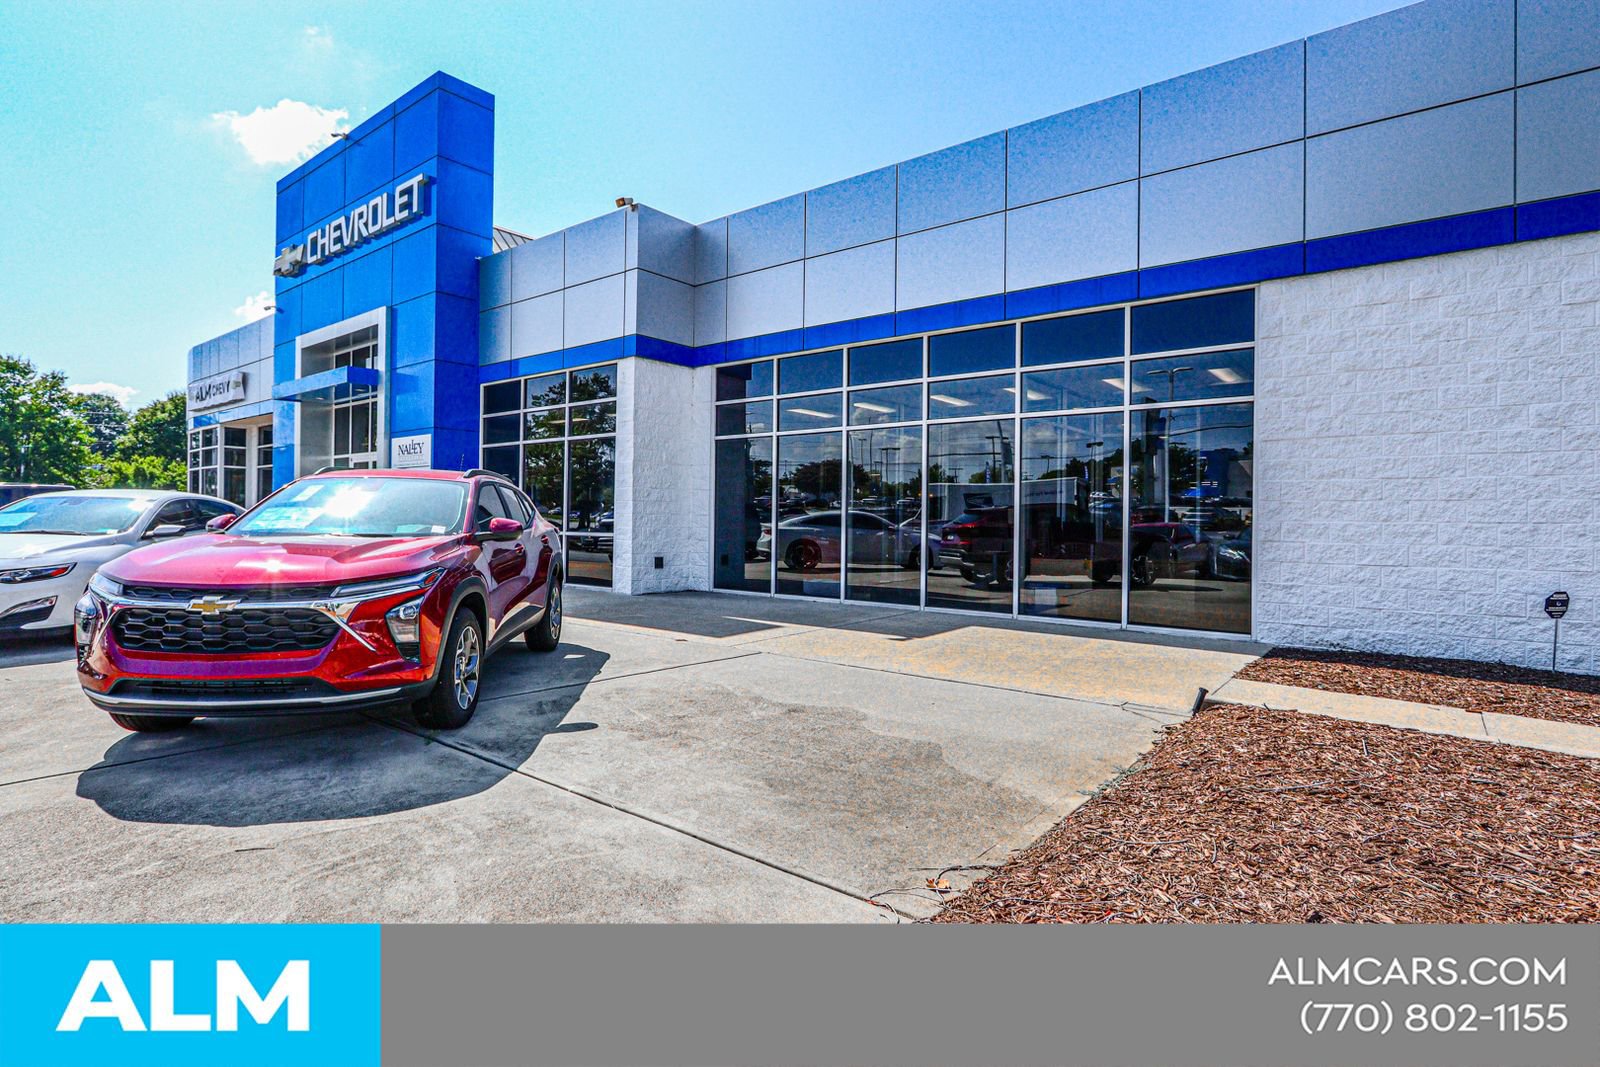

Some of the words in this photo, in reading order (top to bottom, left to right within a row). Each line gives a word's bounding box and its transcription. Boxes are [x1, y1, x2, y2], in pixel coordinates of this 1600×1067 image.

[307, 173, 424, 264] CHEVROLET
[195, 384, 211, 403] ALM
[212, 380, 230, 397] CHEVY
[398, 440, 424, 455] NALLEY
